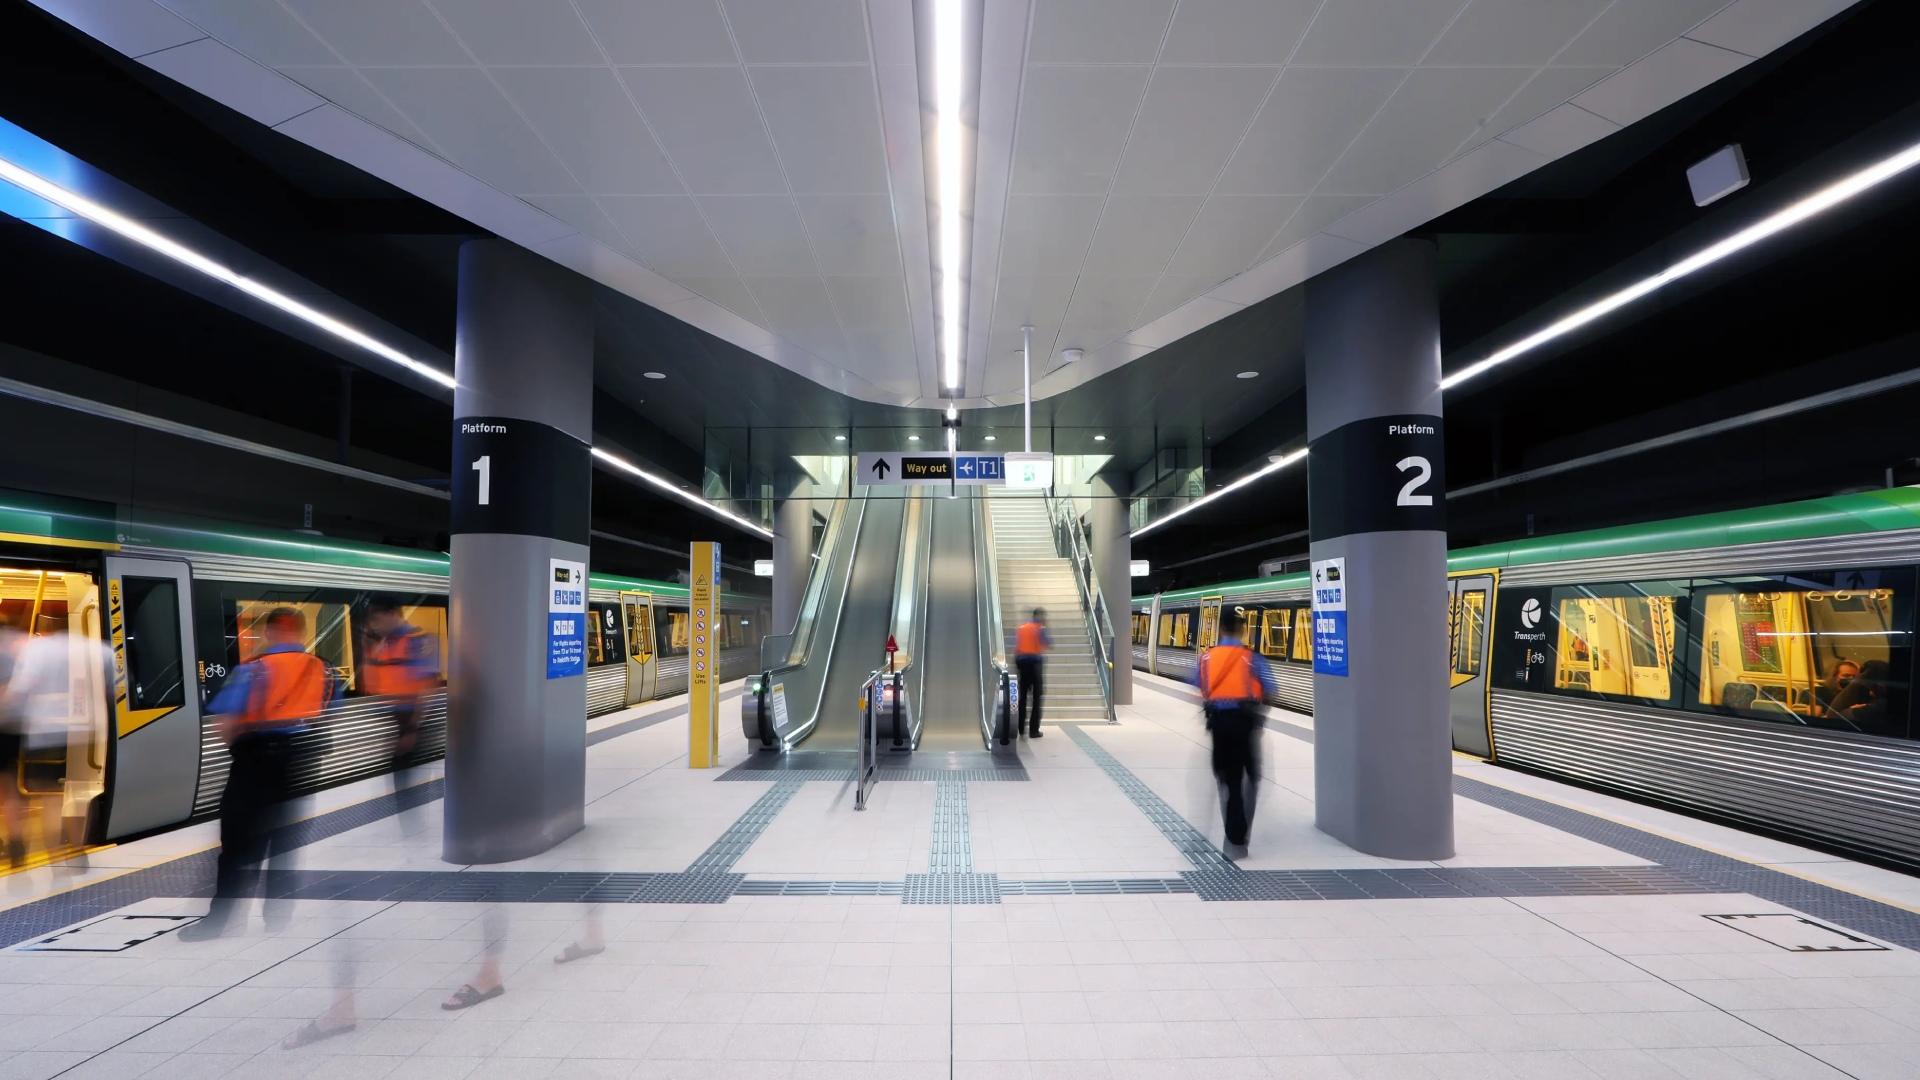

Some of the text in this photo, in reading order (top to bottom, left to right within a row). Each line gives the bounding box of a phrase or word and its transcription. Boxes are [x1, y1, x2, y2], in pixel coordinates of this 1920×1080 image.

[462, 423, 507, 434] Platform
[1389, 424, 1435, 435] Platform
[906, 463, 947, 474] Way out
[979, 461, 998, 475] T1
[472, 455, 490, 505] 1
[1396, 456, 1433, 507] 2
[1514, 630, 1546, 643] Transperth
